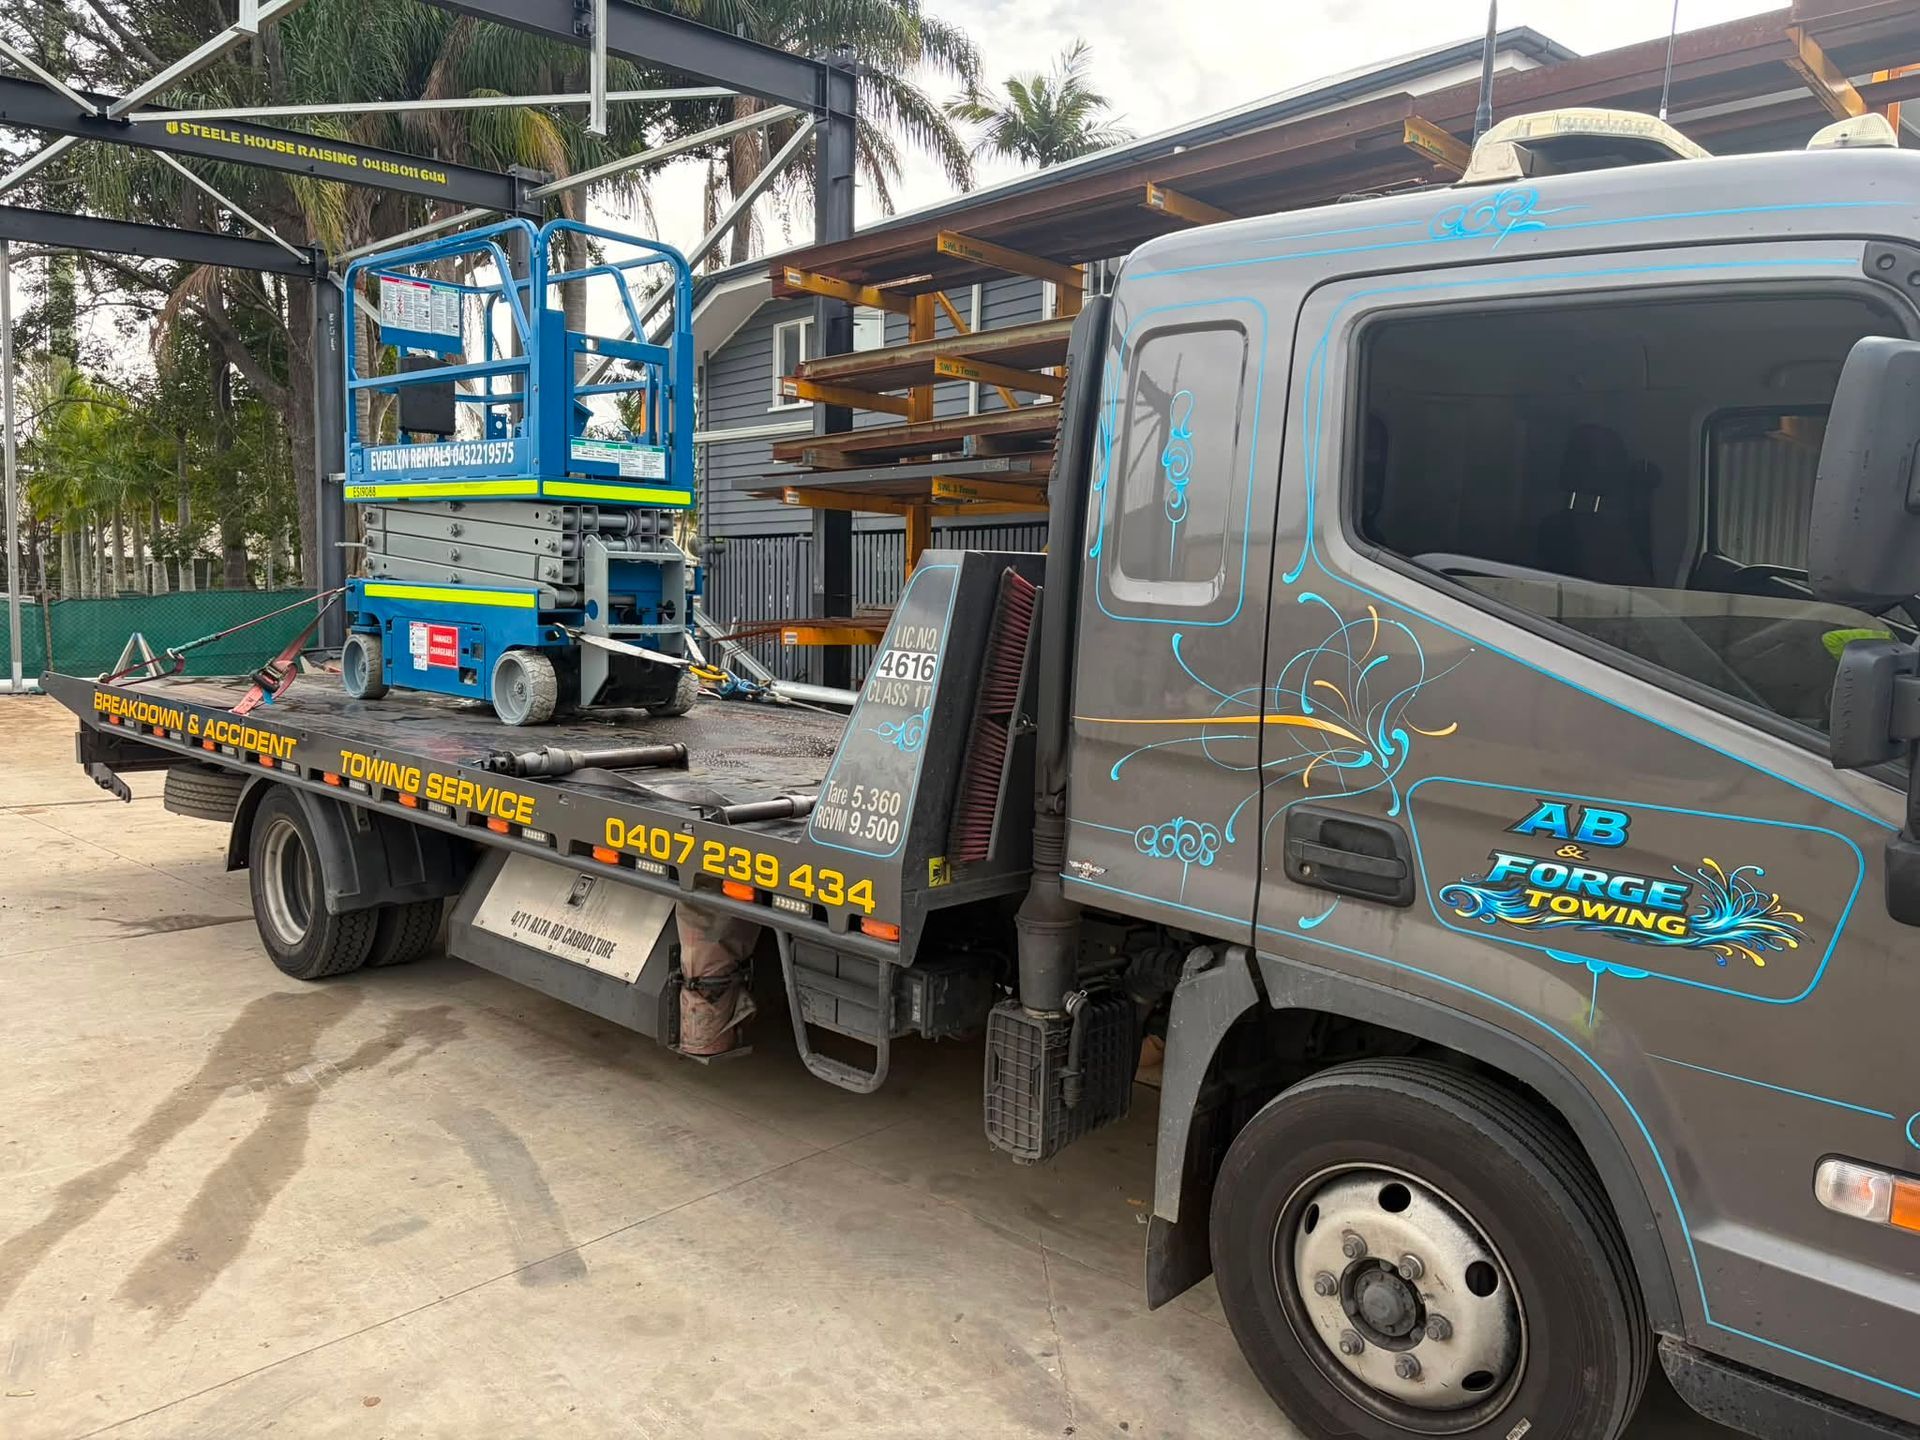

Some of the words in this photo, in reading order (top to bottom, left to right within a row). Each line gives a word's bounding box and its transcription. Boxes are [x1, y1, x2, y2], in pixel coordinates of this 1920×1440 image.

[181, 122, 240, 144] STEELE
[243, 134, 295, 155] HOUSE
[297, 144, 358, 166] RAISING
[370, 447, 410, 471] EVERLYN
[410, 444, 452, 469] RENTALS
[452, 441, 514, 466] 0432219575
[879, 652, 936, 681] 4616
[866, 679, 910, 707] CLASS
[94, 692, 184, 732] BREAKDOWN
[187, 713, 200, 736] &
[203, 722, 298, 760] ACCIDENT
[340, 750, 421, 793] TOWING
[425, 772, 537, 825] SERVICE
[605, 817, 697, 865] 0407
[702, 841, 780, 888] 239
[788, 863, 877, 915] 434
[827, 779, 849, 806] Tare
[851, 785, 902, 818] 5.360
[814, 805, 849, 834] RGVM
[849, 814, 900, 846] 9.500
[1513, 801, 1630, 849] AB
[1555, 844, 1590, 862] &
[1485, 850, 1692, 913] FORGE
[1523, 887, 1690, 937] TOWING
[511, 910, 532, 931] 4/11
[527, 917, 552, 938] ALTA
[548, 923, 564, 942] RD
[561, 927, 617, 959] CABOOLTURE
